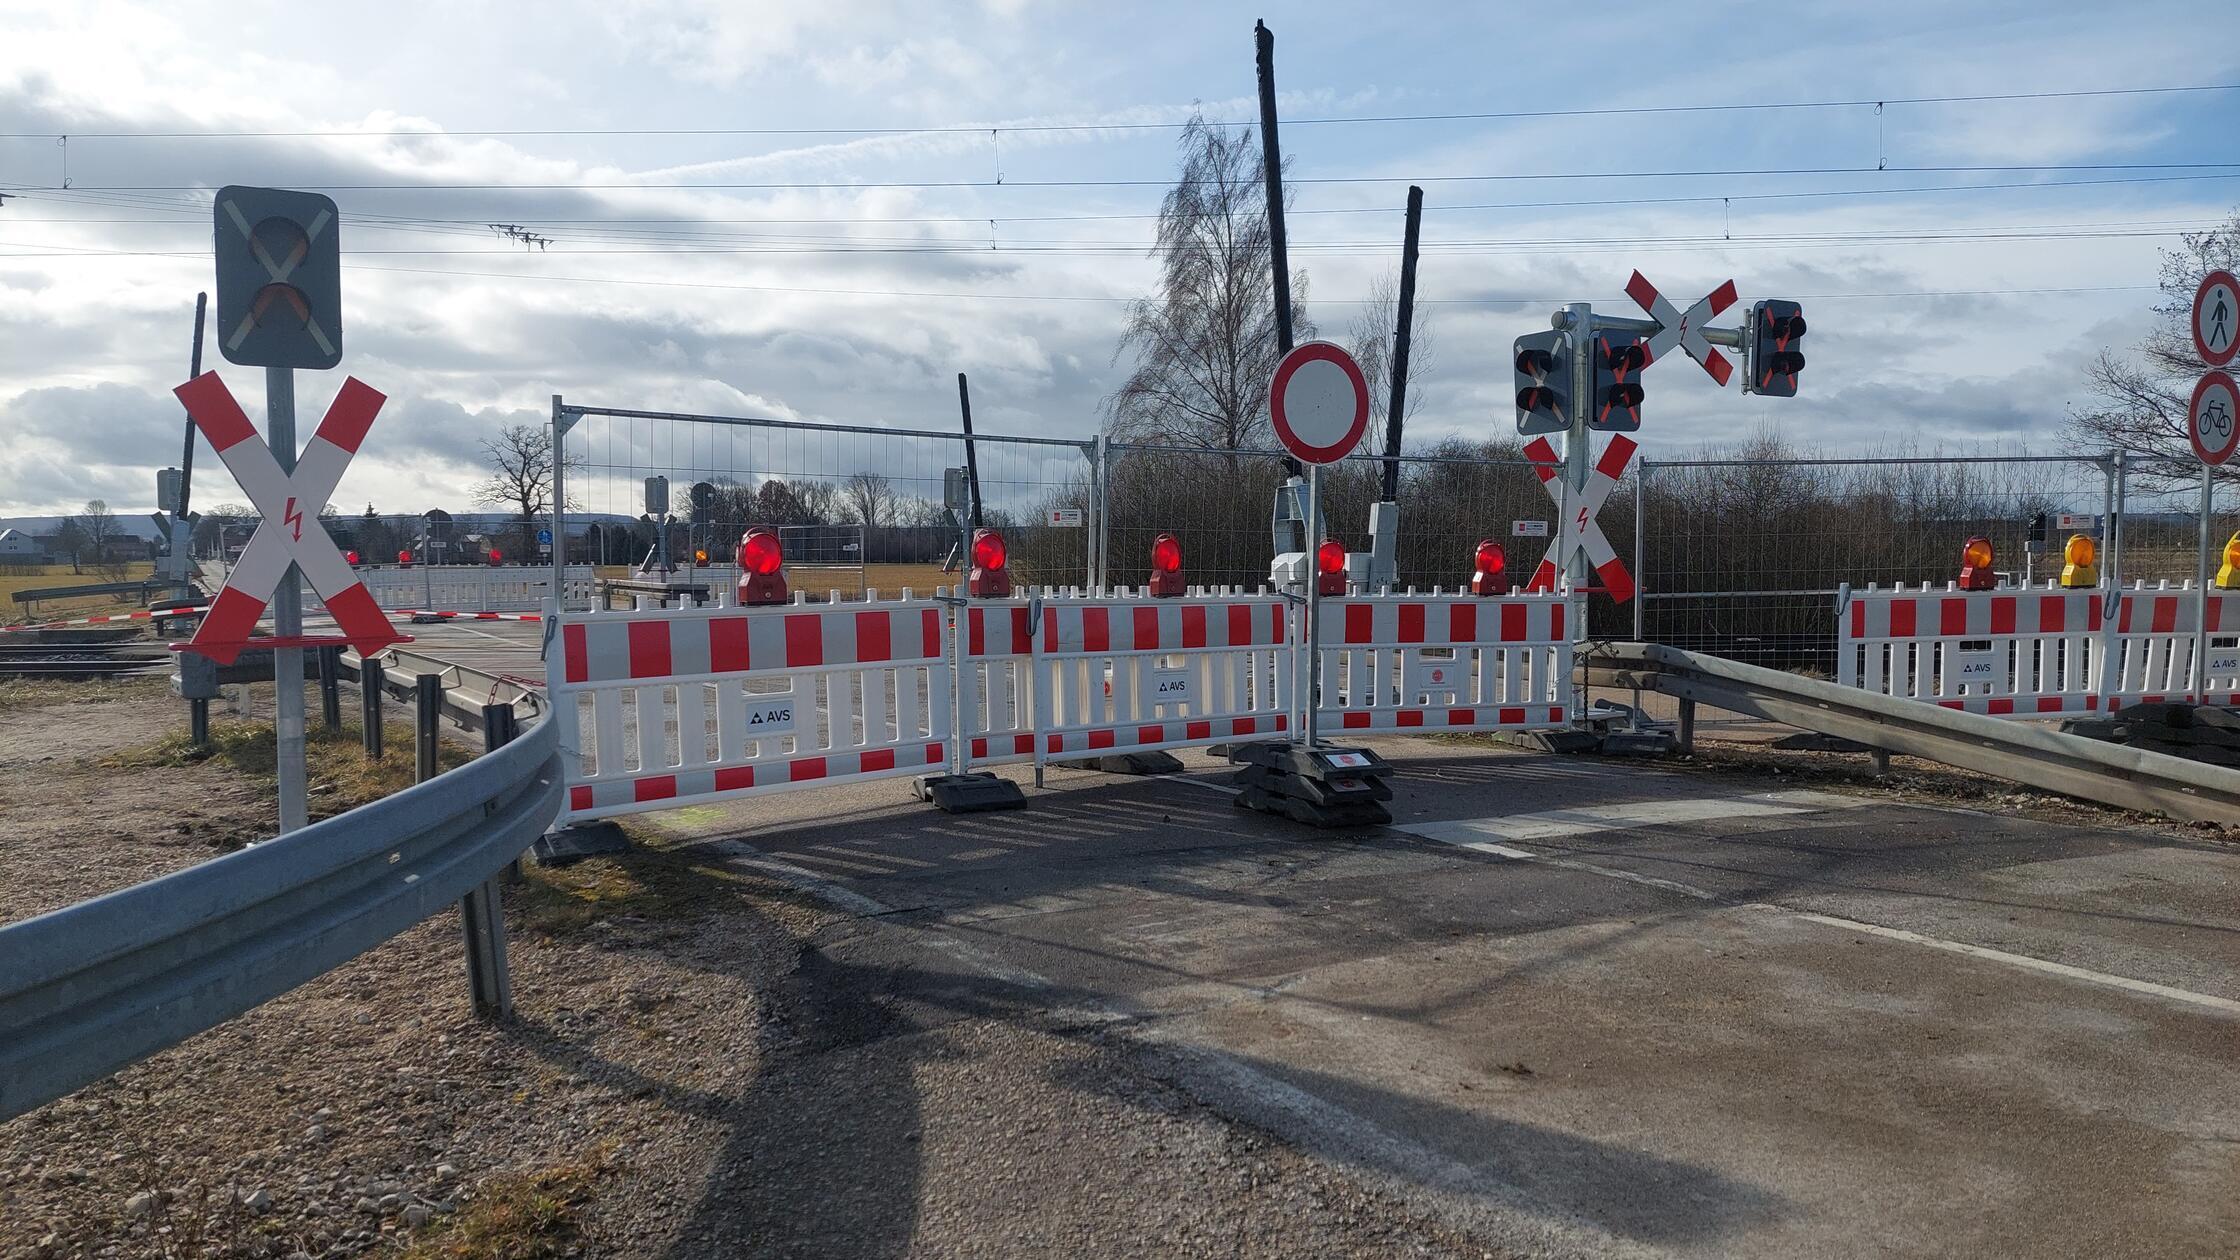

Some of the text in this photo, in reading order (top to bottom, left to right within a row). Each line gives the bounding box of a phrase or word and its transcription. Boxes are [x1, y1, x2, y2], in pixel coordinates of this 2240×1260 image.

[1974, 663, 1991, 672] AVS
[2222, 659, 2237, 668] AVS
[1169, 681, 1185, 691] AVS
[767, 709, 791, 723] AVS
